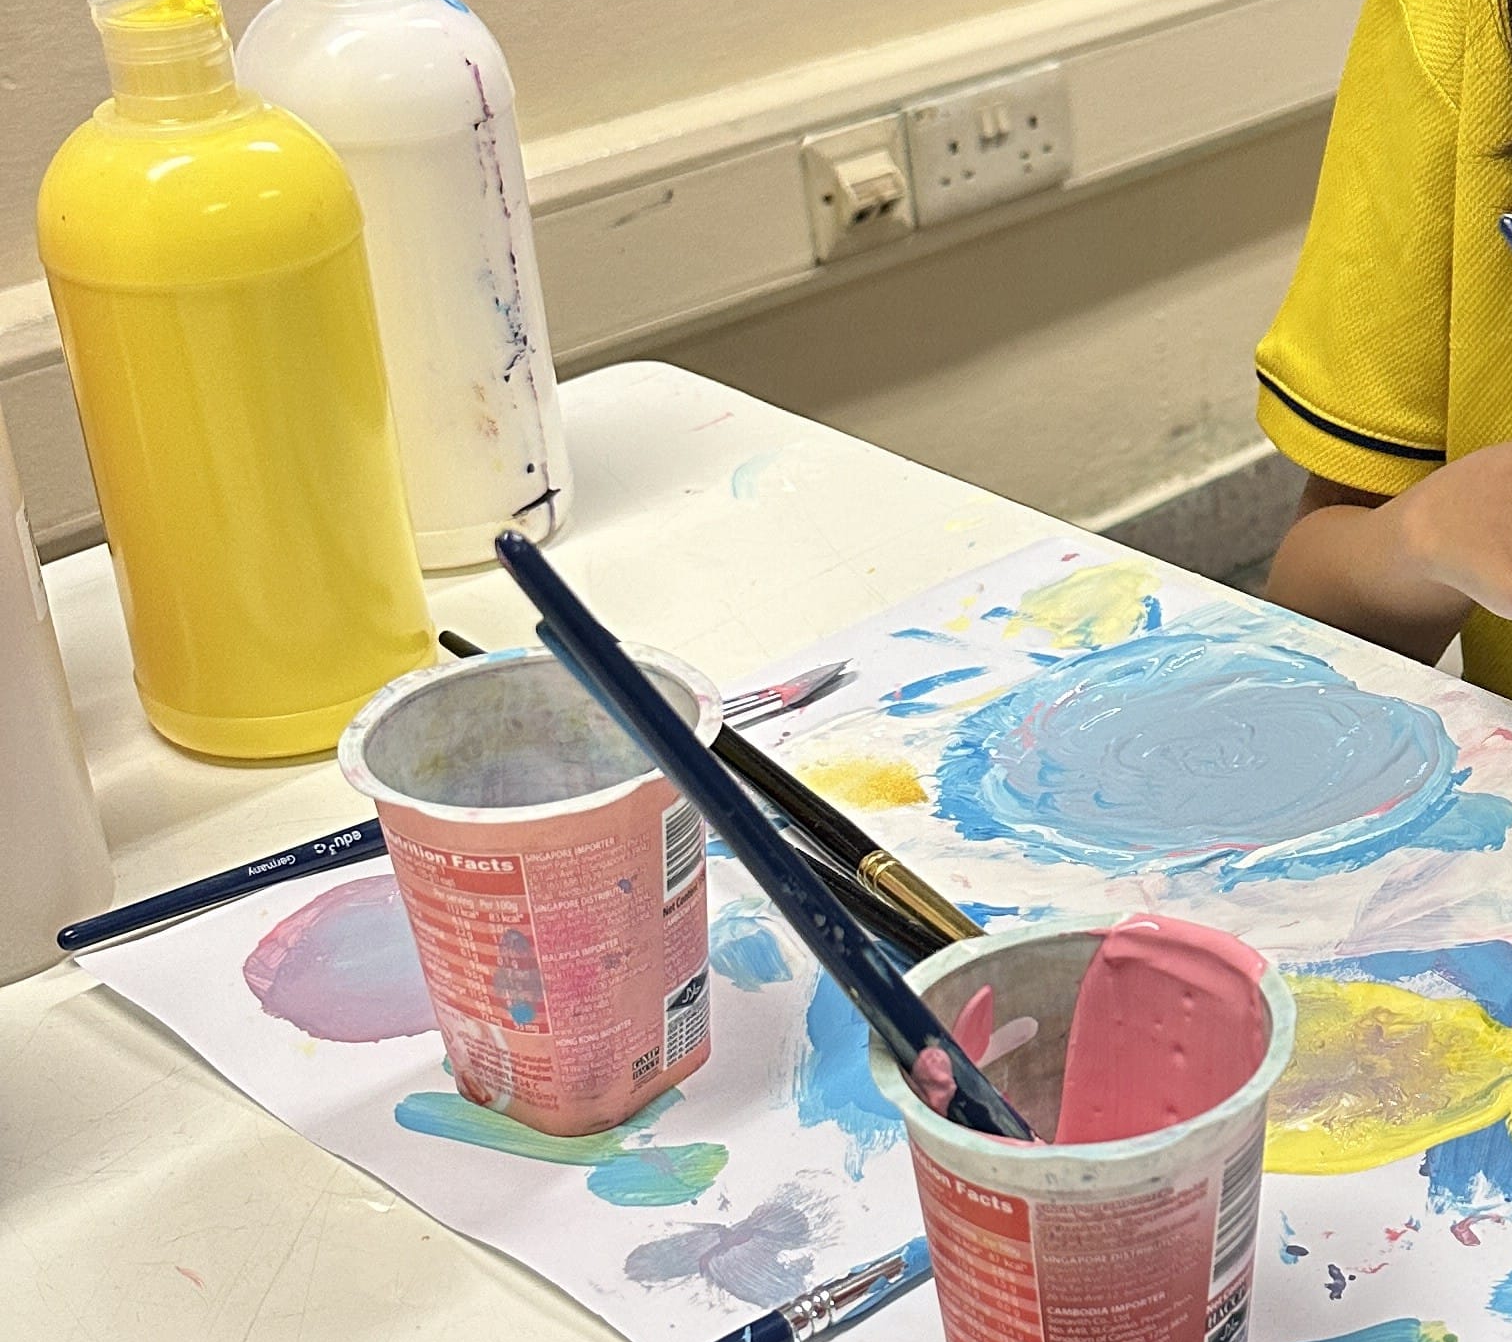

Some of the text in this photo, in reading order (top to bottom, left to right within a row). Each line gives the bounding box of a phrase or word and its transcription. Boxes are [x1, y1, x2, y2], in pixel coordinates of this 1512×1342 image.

[248, 854, 297, 877] Germany
[451, 855, 514, 872] Facts
[955, 1179, 1013, 1214] Facts
[1047, 1291, 1166, 1316] CAMBODIA IMPORTER
